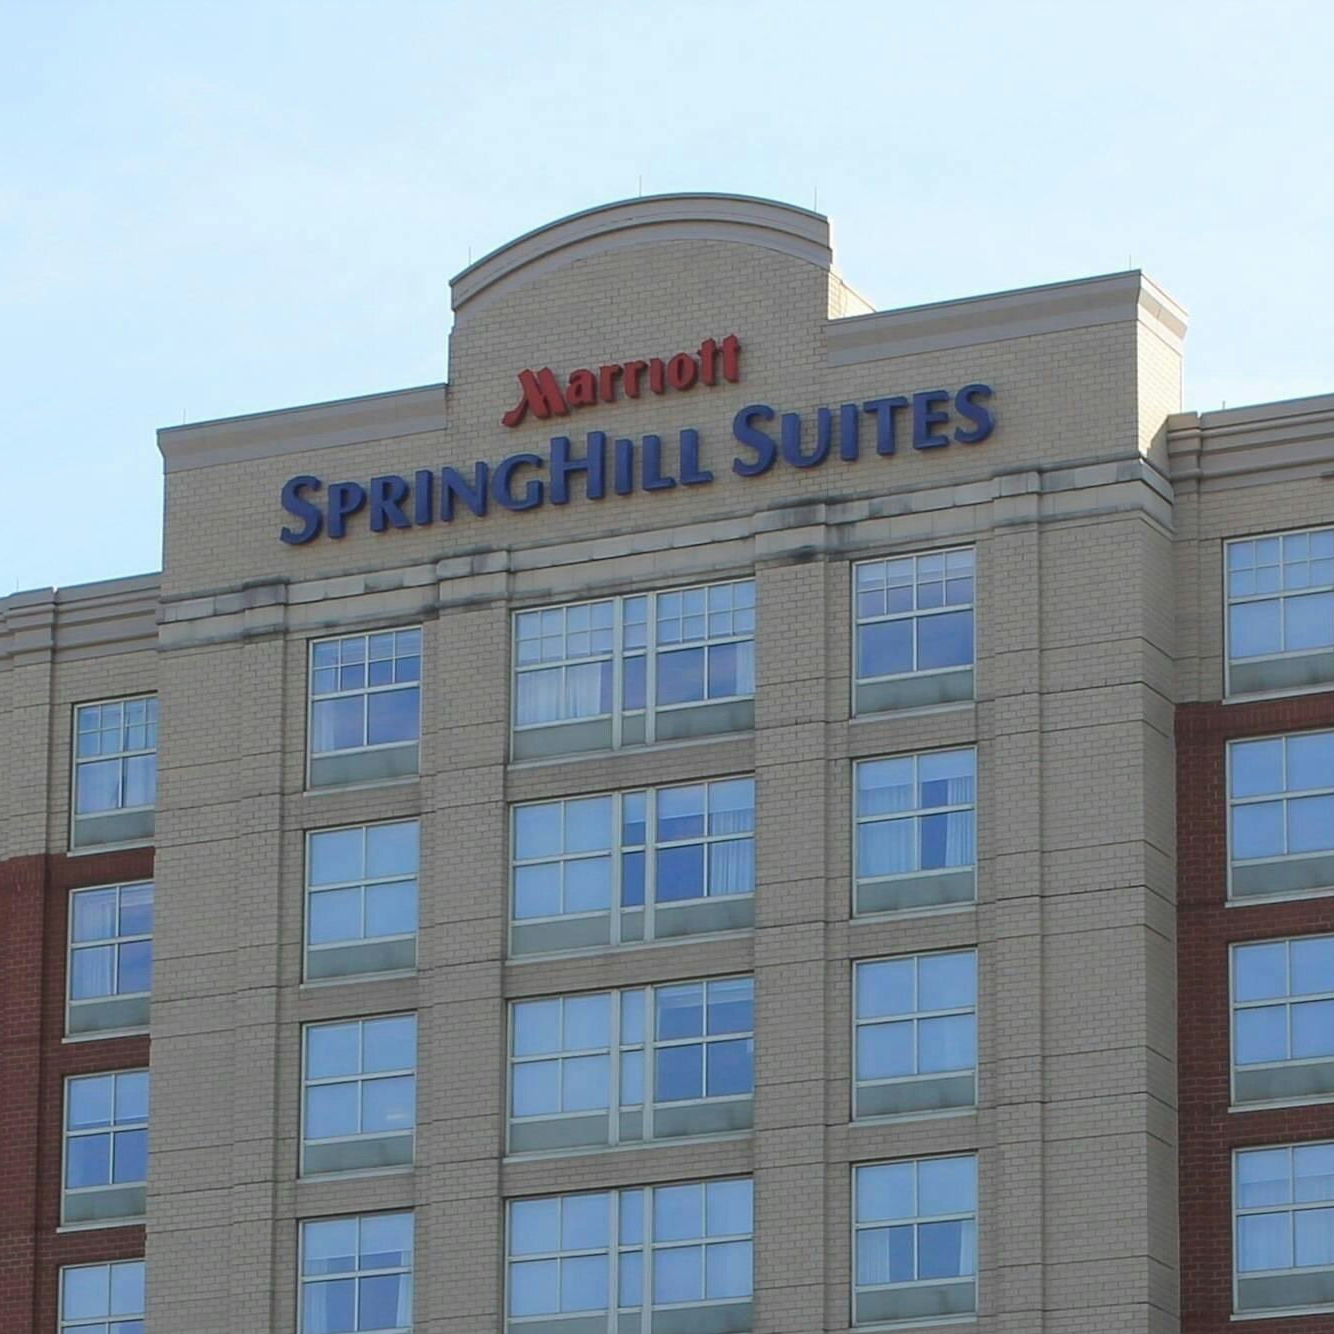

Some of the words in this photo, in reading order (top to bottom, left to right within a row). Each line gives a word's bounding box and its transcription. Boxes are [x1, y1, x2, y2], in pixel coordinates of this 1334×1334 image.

[501, 333, 740, 427] Marriott
[279, 430, 714, 545] SPRINGHILL
[732, 383, 995, 478] SUITES
